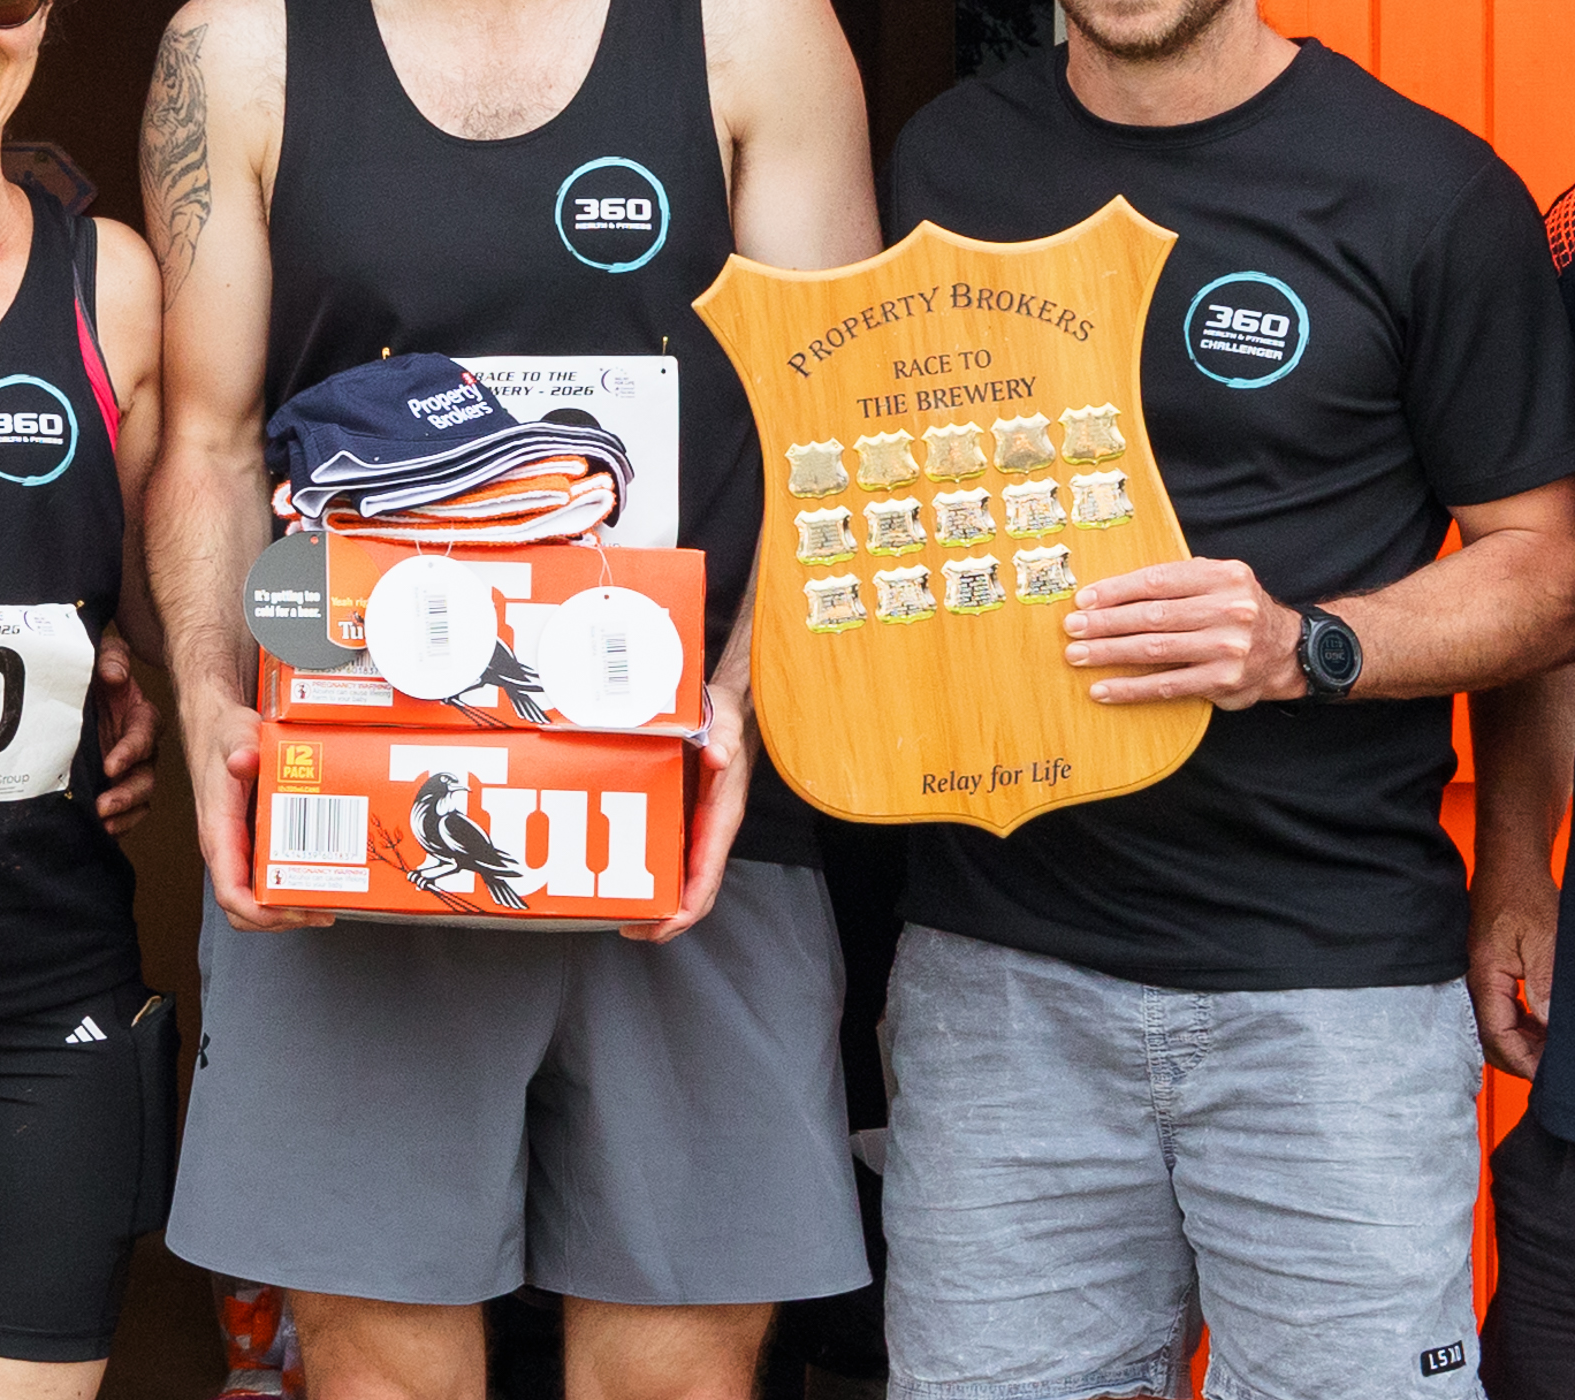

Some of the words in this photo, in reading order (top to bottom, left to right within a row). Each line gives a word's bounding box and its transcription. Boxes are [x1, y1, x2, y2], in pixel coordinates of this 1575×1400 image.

[575, 198, 652, 221] 360
[787, 286, 940, 379] PROPERTY
[950, 282, 1095, 342] BROKERS
[1205, 304, 1290, 338] 360
[1203, 329, 1237, 340] HEALTH
[1245, 334, 1285, 348] FITNESS
[1200, 339, 1283, 361] CHALLENGER
[893, 354, 952, 379] RACE
[958, 349, 992, 371] TO
[474, 371, 516, 381] RACE
[522, 371, 541, 381] TO
[549, 371, 578, 381] THE
[407, 383, 483, 419] Property
[488, 386, 534, 396] WERY
[550, 385, 595, 396] 2026
[856, 393, 908, 419] THE
[916, 376, 1036, 412] BREWERY
[427, 401, 494, 430] Brokers
[254, 590, 270, 602] It's
[270, 590, 304, 604] getting
[304, 590, 321, 602] too
[331, 597, 352, 607] Yeah
[355, 597, 369, 608] rig
[254, 605, 275, 617] cold
[275, 605, 290, 617] for
[290, 608, 297, 617] a
[338, 621, 364, 639] Tu
[286, 745, 313, 765] 12
[283, 766, 315, 778] PACK
[922, 770, 982, 795] Relay
[987, 764, 1023, 793] for
[1032, 757, 1072, 787] Life
